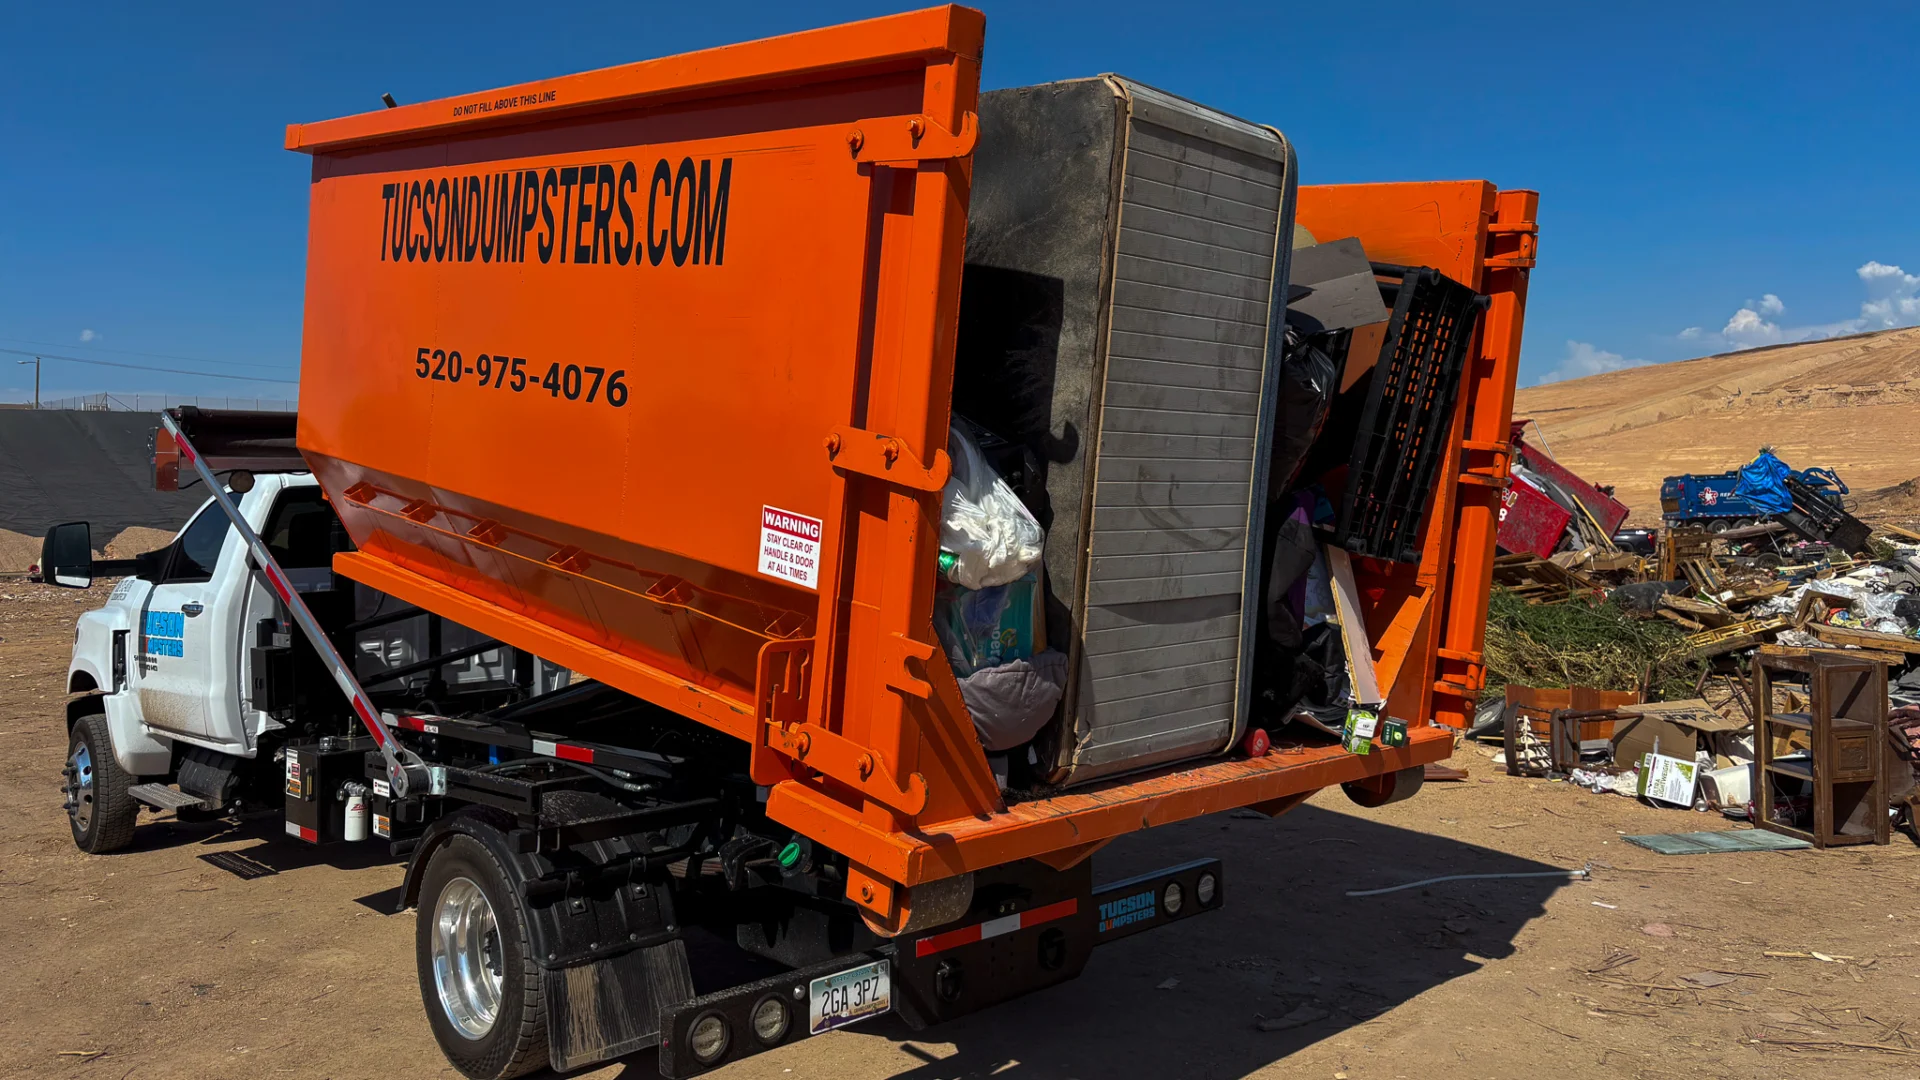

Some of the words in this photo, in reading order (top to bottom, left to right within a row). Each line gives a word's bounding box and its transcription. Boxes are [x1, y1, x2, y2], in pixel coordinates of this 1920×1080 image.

[453, 106, 463, 117] DO
[463, 104, 479, 115] NOT
[479, 101, 493, 113] FILL
[494, 97, 518, 111] ABOVE
[519, 93, 537, 107] THIS
[538, 90, 557, 103] LINE
[381, 156, 733, 267] TUCSONDUMPSTERS.COM
[415, 347, 629, 408] 520-975-4076
[764, 511, 819, 538] WARNING
[763, 545, 789, 562] HANDLE
[789, 553, 794, 563] &
[795, 554, 814, 569] DOOR
[766, 532, 782, 546] STAY
[782, 537, 804, 553] CLEAR
[804, 543, 813, 555] OF
[767, 561, 776, 571] AT
[776, 563, 788, 575] ALL
[789, 566, 808, 581] TIMES
[1099, 889, 1155, 920] TUCSON
[1099, 906, 1156, 933] DUMPSTERS
[821, 984, 849, 1018] 2GA
[853, 975, 880, 1007] 3PZ
